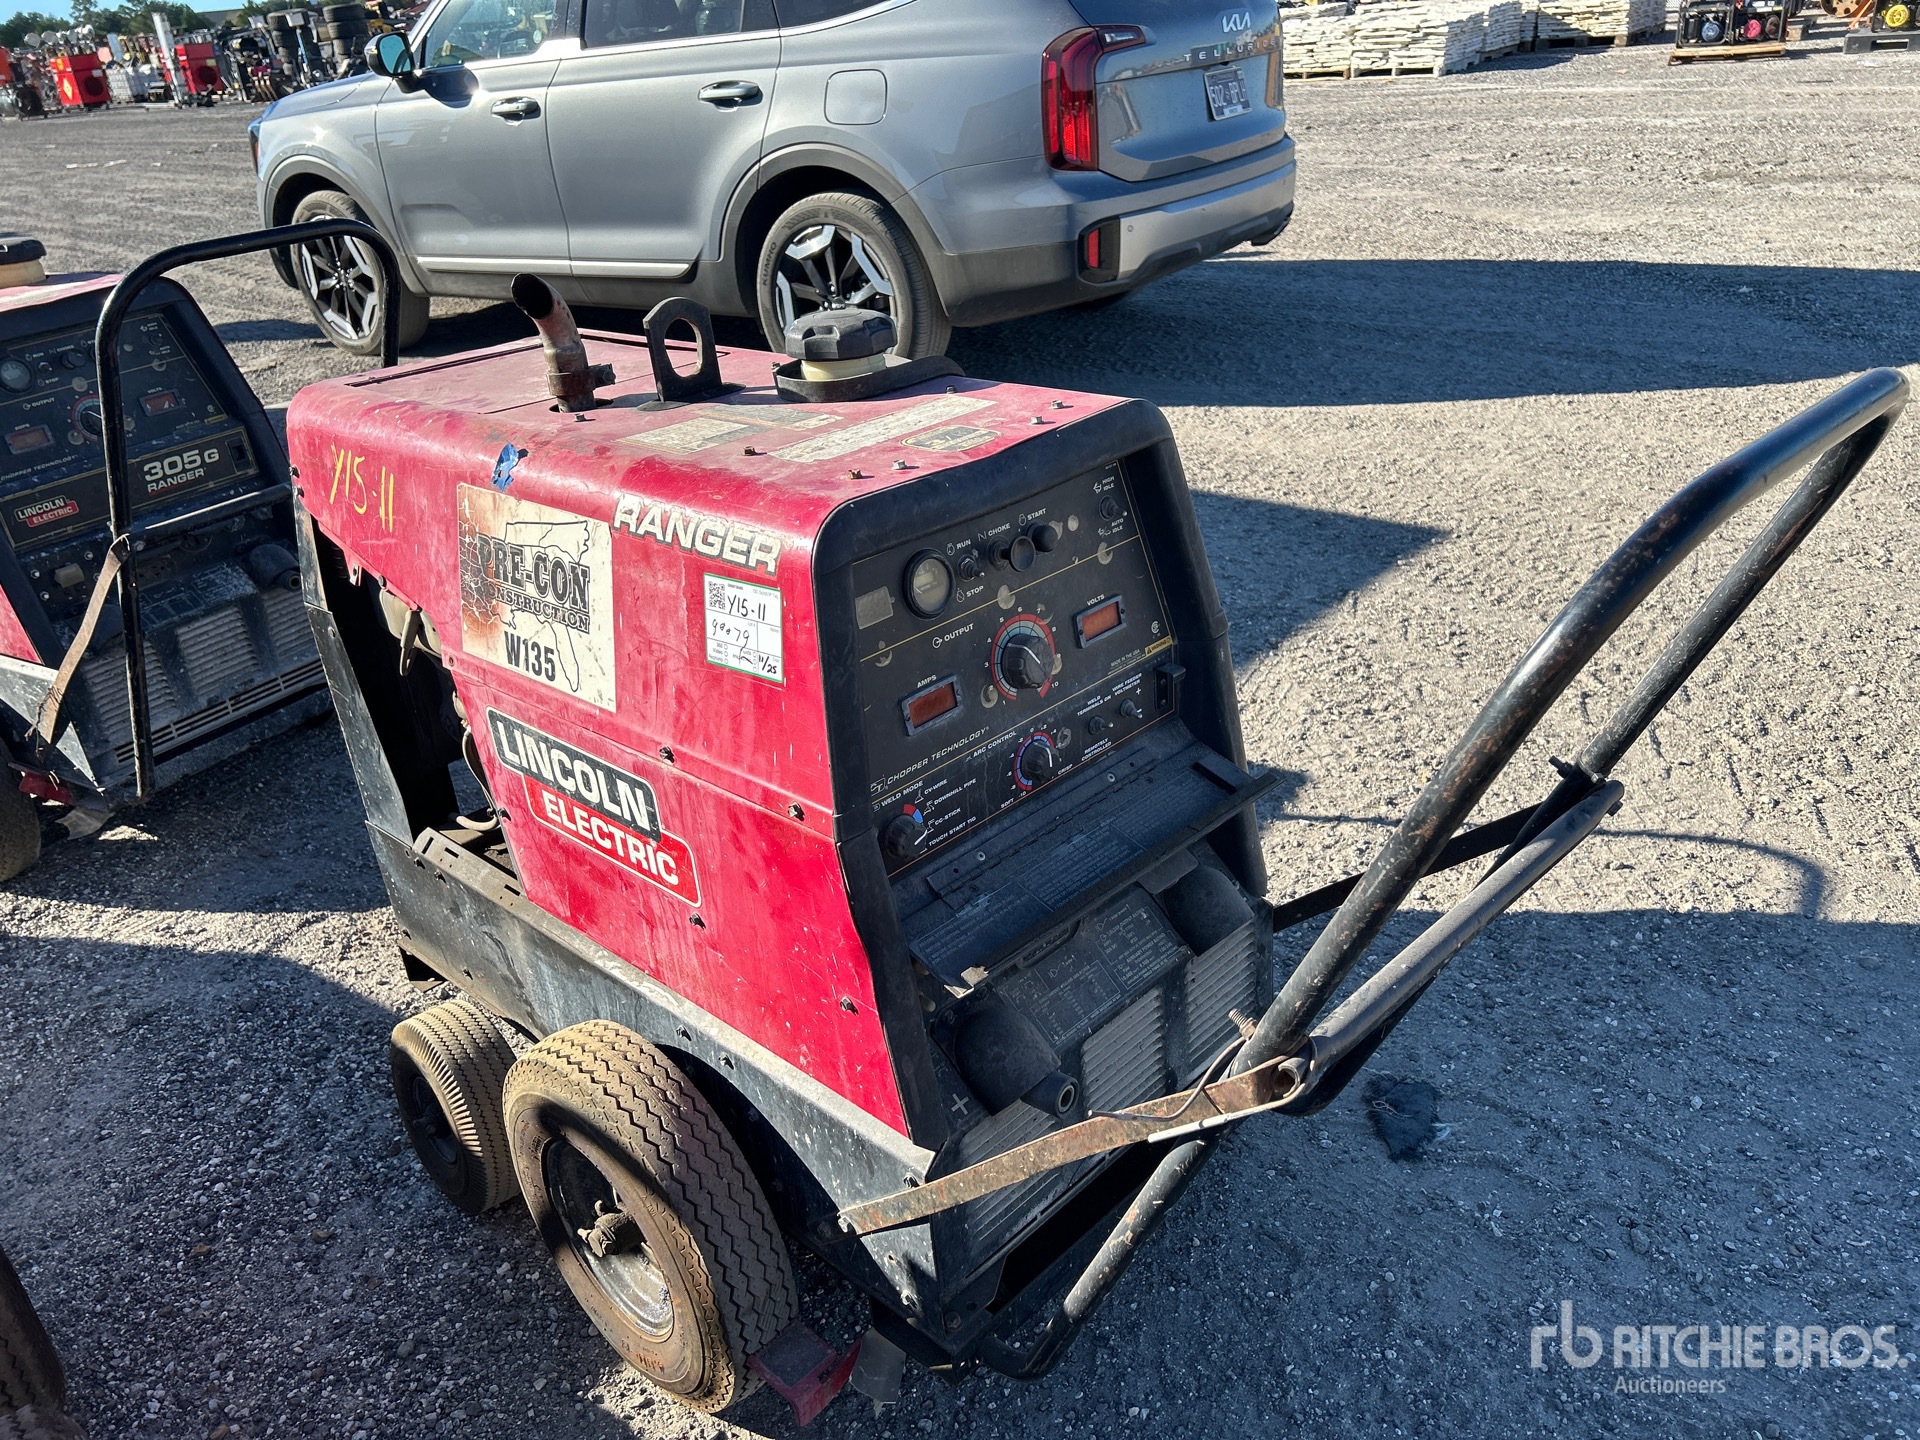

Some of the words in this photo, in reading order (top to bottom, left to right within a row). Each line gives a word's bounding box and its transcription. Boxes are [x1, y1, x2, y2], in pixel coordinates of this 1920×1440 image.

[1184, 41, 1275, 62] TELLURIDE
[763, 242, 776, 286] KUMHO
[32, 398, 55, 407] OUTPUT
[1, 467, 32, 481] CHOPPER
[143, 449, 201, 481] 305
[147, 468, 204, 493] RANGER
[1103, 483, 1115, 491] IDLE
[18, 498, 65, 519] LINCOLN
[33, 506, 73, 524] ELECTRIC
[1027, 508, 1047, 521] START
[988, 523, 1011, 537] CHOKE
[1111, 518, 1124, 527] AUTO
[1112, 525, 1123, 533] IDLE
[612, 491, 782, 575] RANGER
[957, 539, 971, 550] RUN
[477, 532, 590, 614] PRE-CON
[966, 586, 984, 598] STOP
[1087, 594, 1105, 606] VOLTS
[727, 594, 766, 621] Y15-11
[944, 623, 974, 642] OUTPUT
[505, 630, 556, 682] W135
[917, 675, 937, 688] AMPS
[1112, 682, 1124, 692] WIRE
[1077, 700, 1103, 716] TERMINALS
[1087, 695, 1101, 705] WELD
[973, 747, 986, 758] ARC
[988, 731, 1017, 748] CONTROL
[1081, 741, 1112, 761] CONTROLLED
[1084, 738, 1108, 754] REMOTELY
[497, 720, 651, 831] LINCOLN
[887, 758, 928, 784] CHOPPER
[1058, 764, 1073, 775] CRISP
[881, 793, 901, 807] WELD
[903, 781, 923, 796] MODE
[924, 779, 948, 795] CV-WIRE
[934, 786, 962, 805] DOWNHILL
[963, 778, 977, 789] PIPE
[1000, 798, 1014, 808] SOFT
[934, 807, 961, 826] CC-STICK
[541, 789, 679, 886] ELECTRIC
[929, 832, 948, 846] TOUCH
[949, 821, 966, 835] START
[967, 816, 977, 824] TIG
